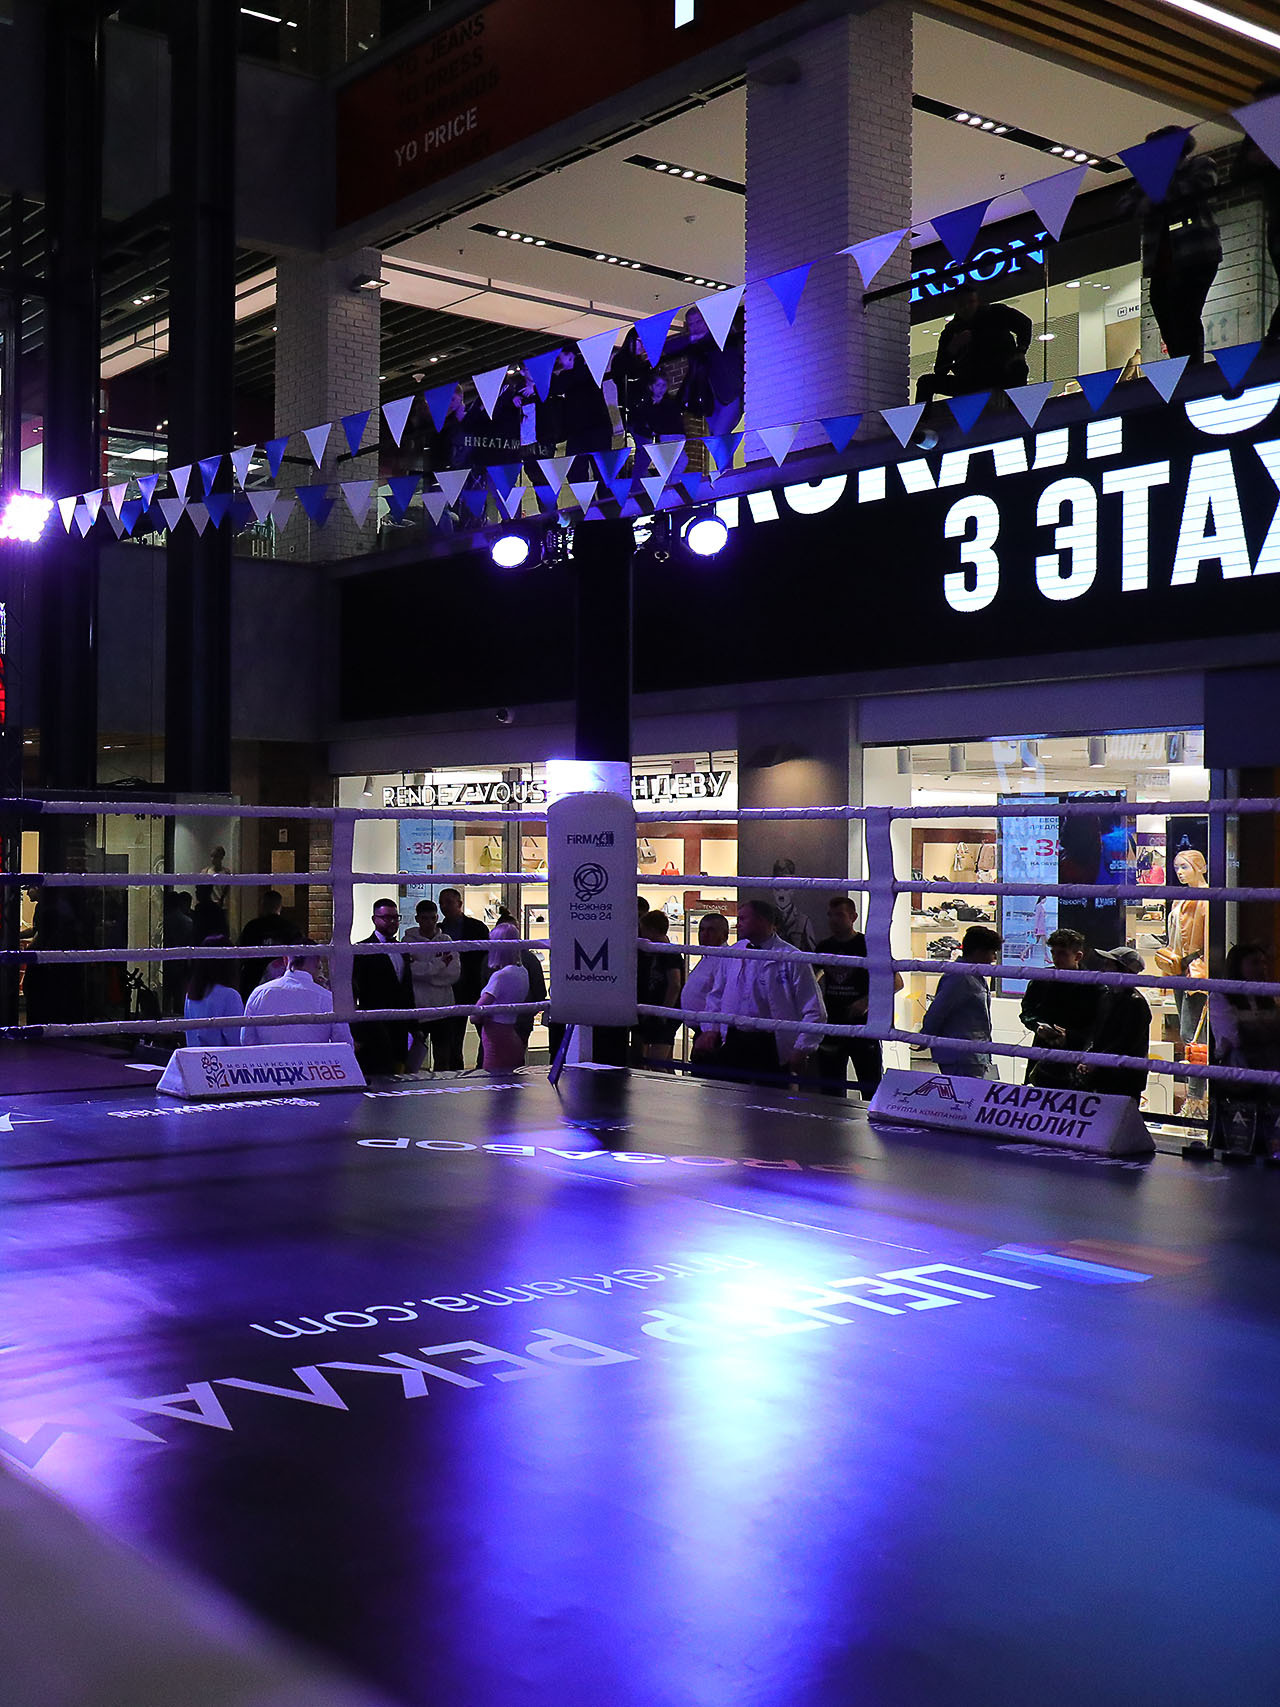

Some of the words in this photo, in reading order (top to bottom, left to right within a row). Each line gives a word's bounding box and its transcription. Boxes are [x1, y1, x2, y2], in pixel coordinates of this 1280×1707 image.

[394, 140, 418, 168] YO
[423, 106, 479, 153] PRICE
[943, 494, 1001, 614] 3
[381, 779, 547, 809] RENDEZ-VOUS
[631, 770, 732, 804] НДЕВУ
[569, 902, 613, 911] Нежная
[570, 911, 597, 921] Роза
[598, 911, 612, 921] 24
[983, 1083, 1101, 1118] КАРКАС
[973, 1106, 1093, 1139] МОНОЛИТ
